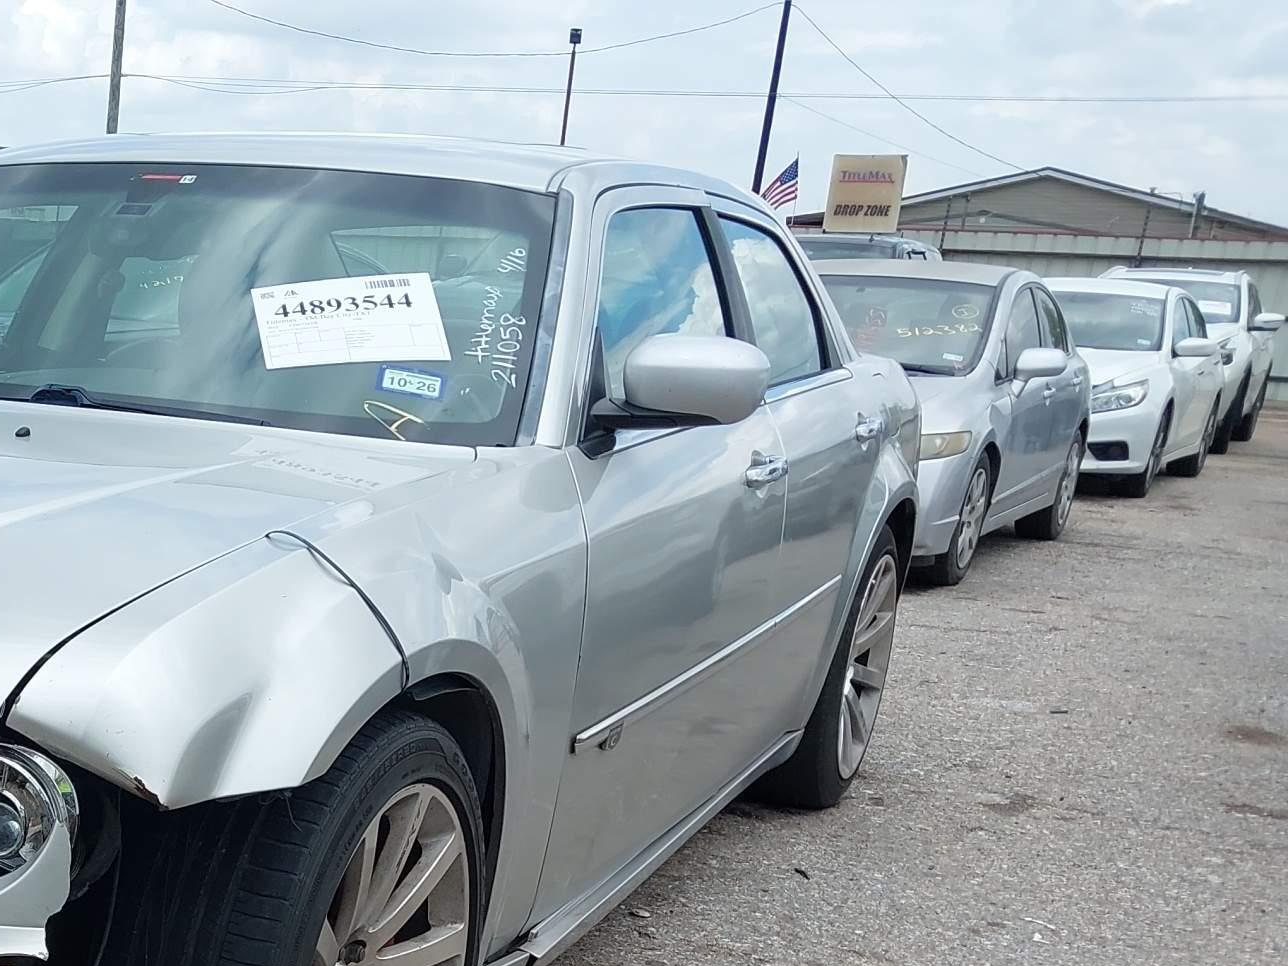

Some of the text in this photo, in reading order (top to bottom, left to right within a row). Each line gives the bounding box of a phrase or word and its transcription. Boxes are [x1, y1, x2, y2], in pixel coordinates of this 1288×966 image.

[833, 204, 892, 217] DROP ZONE
[274, 292, 413, 318] 44893544
[491, 313, 527, 389] 211058
[388, 375, 437, 394] 10 26
[364, 400, 424, 441] A
